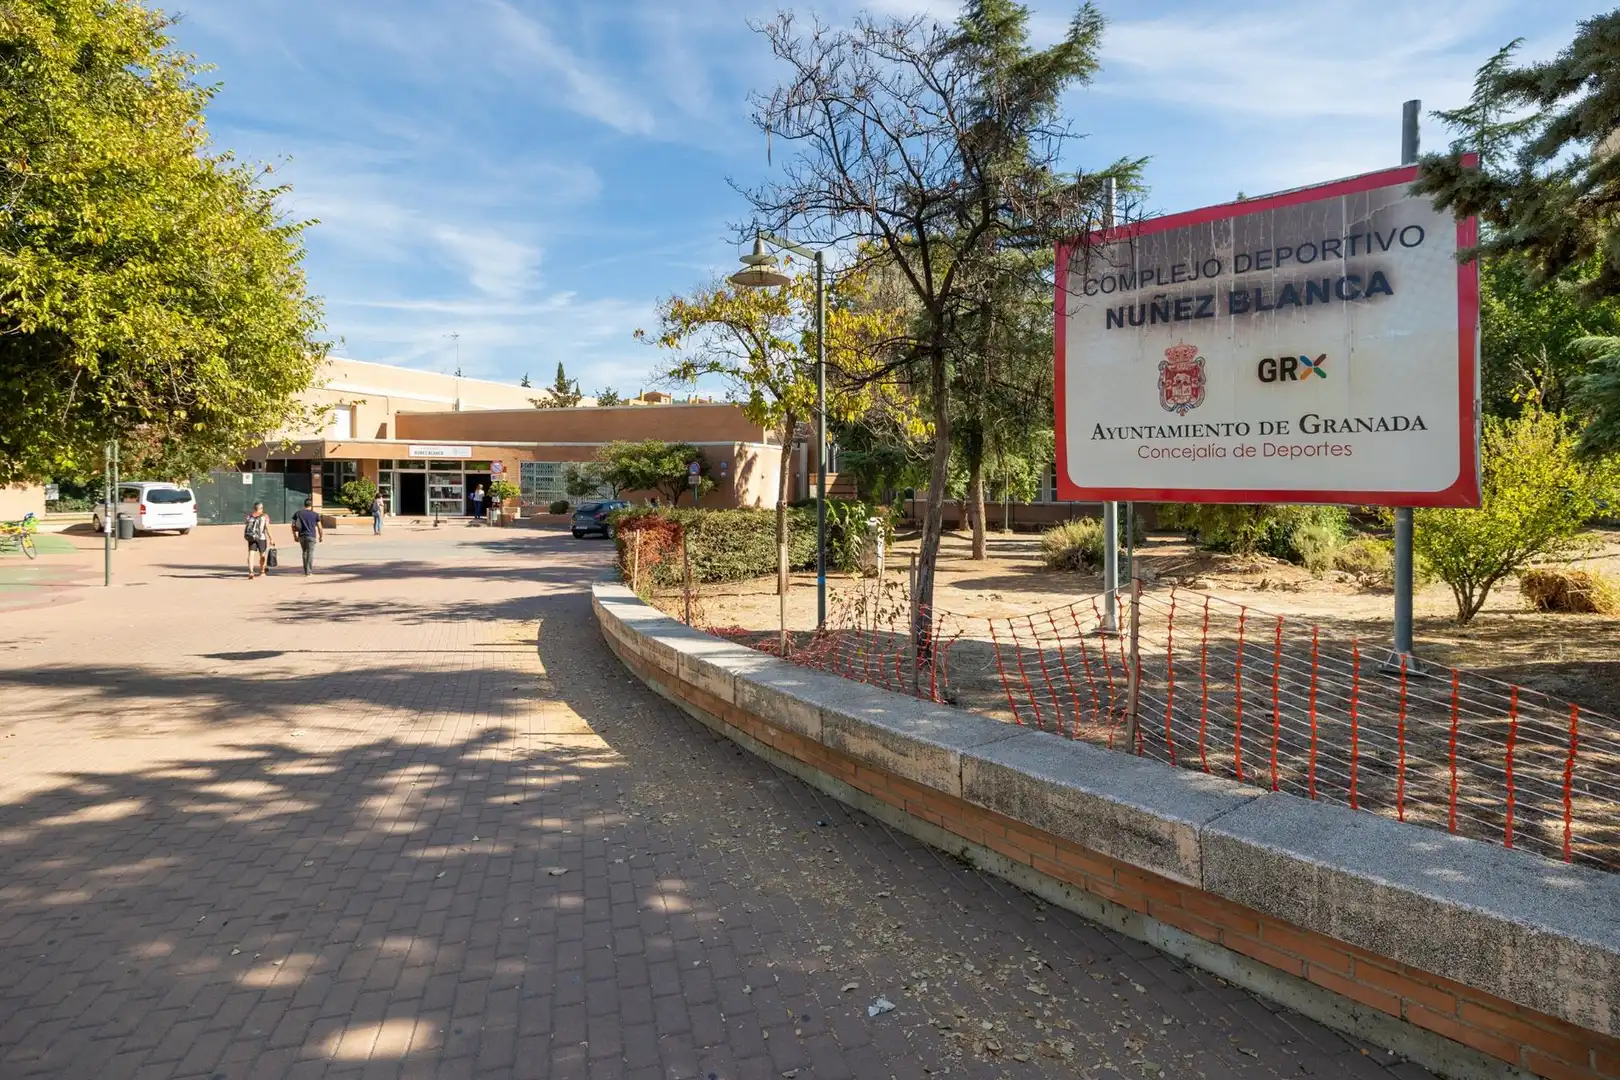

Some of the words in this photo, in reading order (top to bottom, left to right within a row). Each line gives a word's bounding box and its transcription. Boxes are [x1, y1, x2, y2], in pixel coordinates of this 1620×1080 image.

[1083, 258, 1221, 297] COMPLEJO
[1234, 224, 1426, 274] DEPORTIVO
[1106, 292, 1215, 330] NUÑEZ
[1228, 270, 1395, 315] BLANCA
[1137, 442, 1228, 462] Concejalía
[1234, 443, 1257, 458] de
[1263, 441, 1353, 461] Deportes
